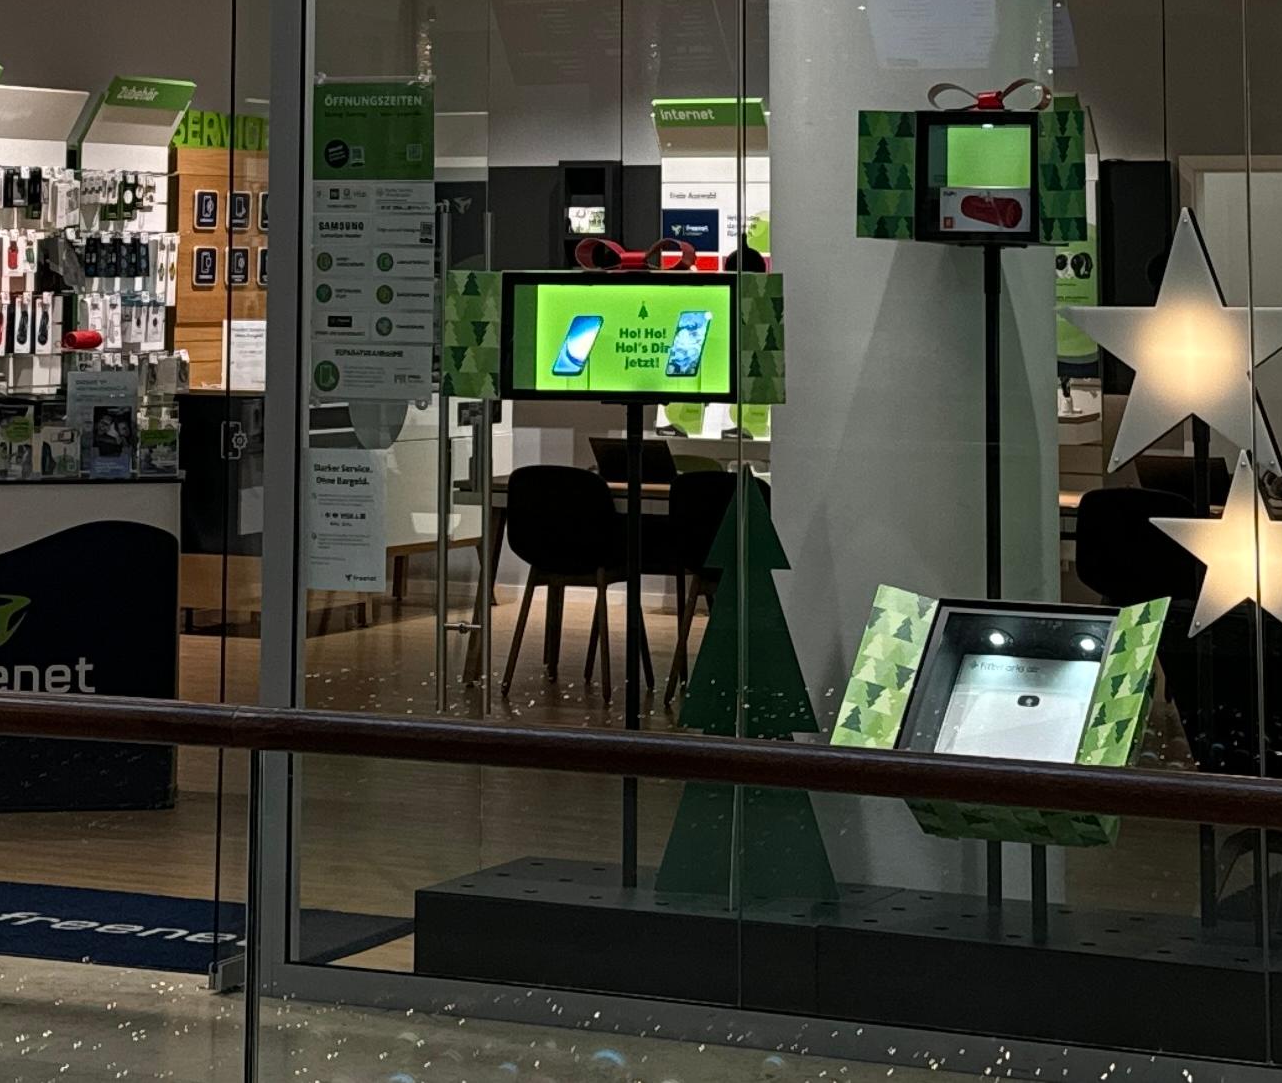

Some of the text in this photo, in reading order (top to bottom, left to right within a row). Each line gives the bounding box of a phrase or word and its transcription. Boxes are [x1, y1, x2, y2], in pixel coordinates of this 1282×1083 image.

[116, 84, 159, 101] Zubehör
[324, 94, 422, 107] ÖFFNUNGSZEITEN
[619, 327, 667, 339] Ho! Ho!
[615, 342, 649, 354] Hol's
